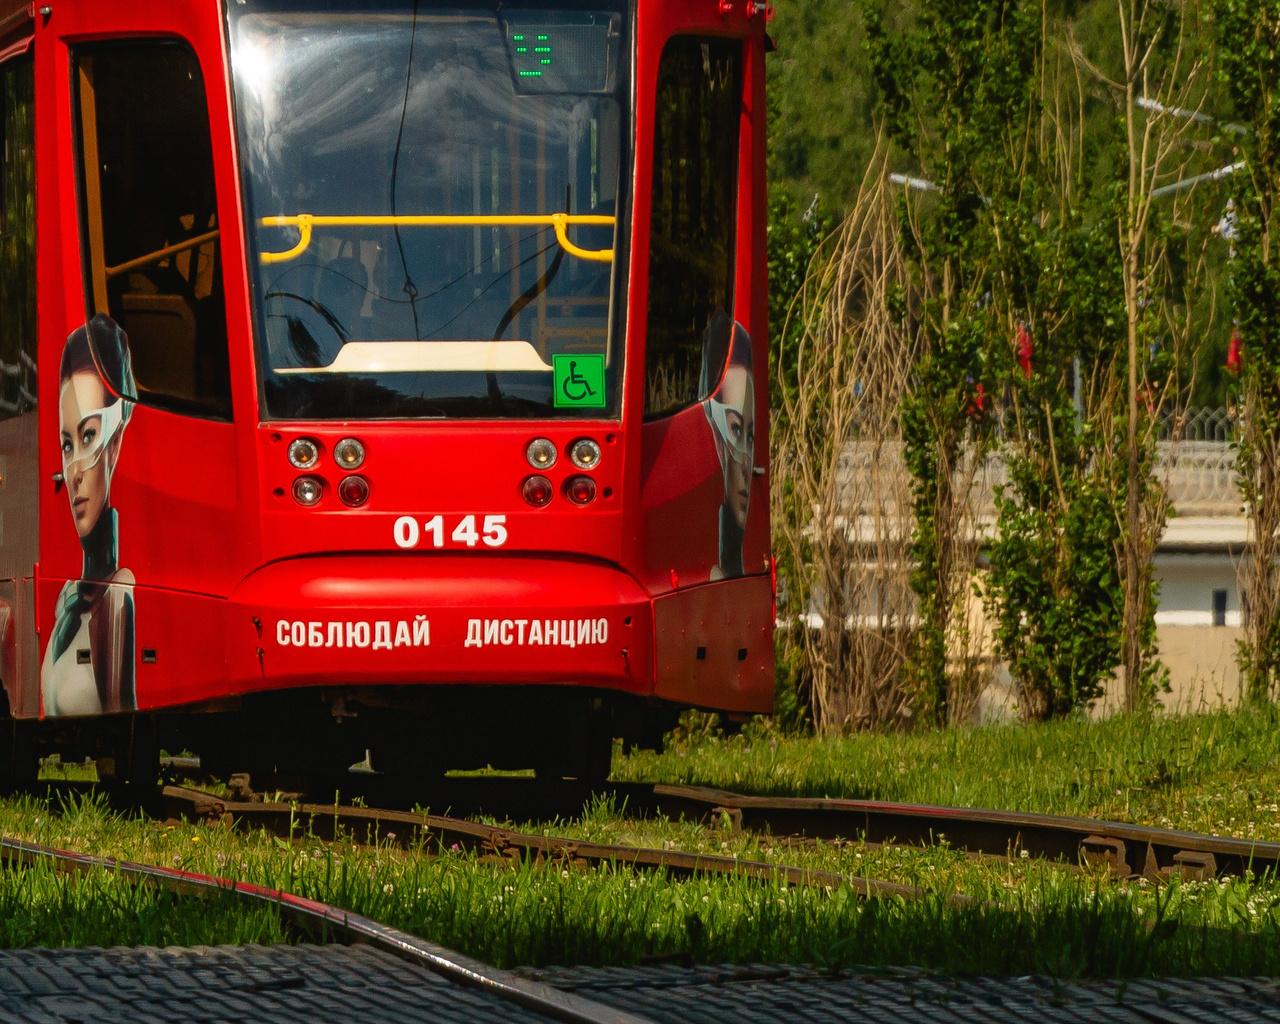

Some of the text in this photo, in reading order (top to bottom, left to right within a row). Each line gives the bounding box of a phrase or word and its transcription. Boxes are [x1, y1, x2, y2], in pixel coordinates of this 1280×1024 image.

[394, 515, 508, 549] 0145
[276, 615, 608, 650] СОБЛЮДАЙ ДИСТАНЦИЮ
